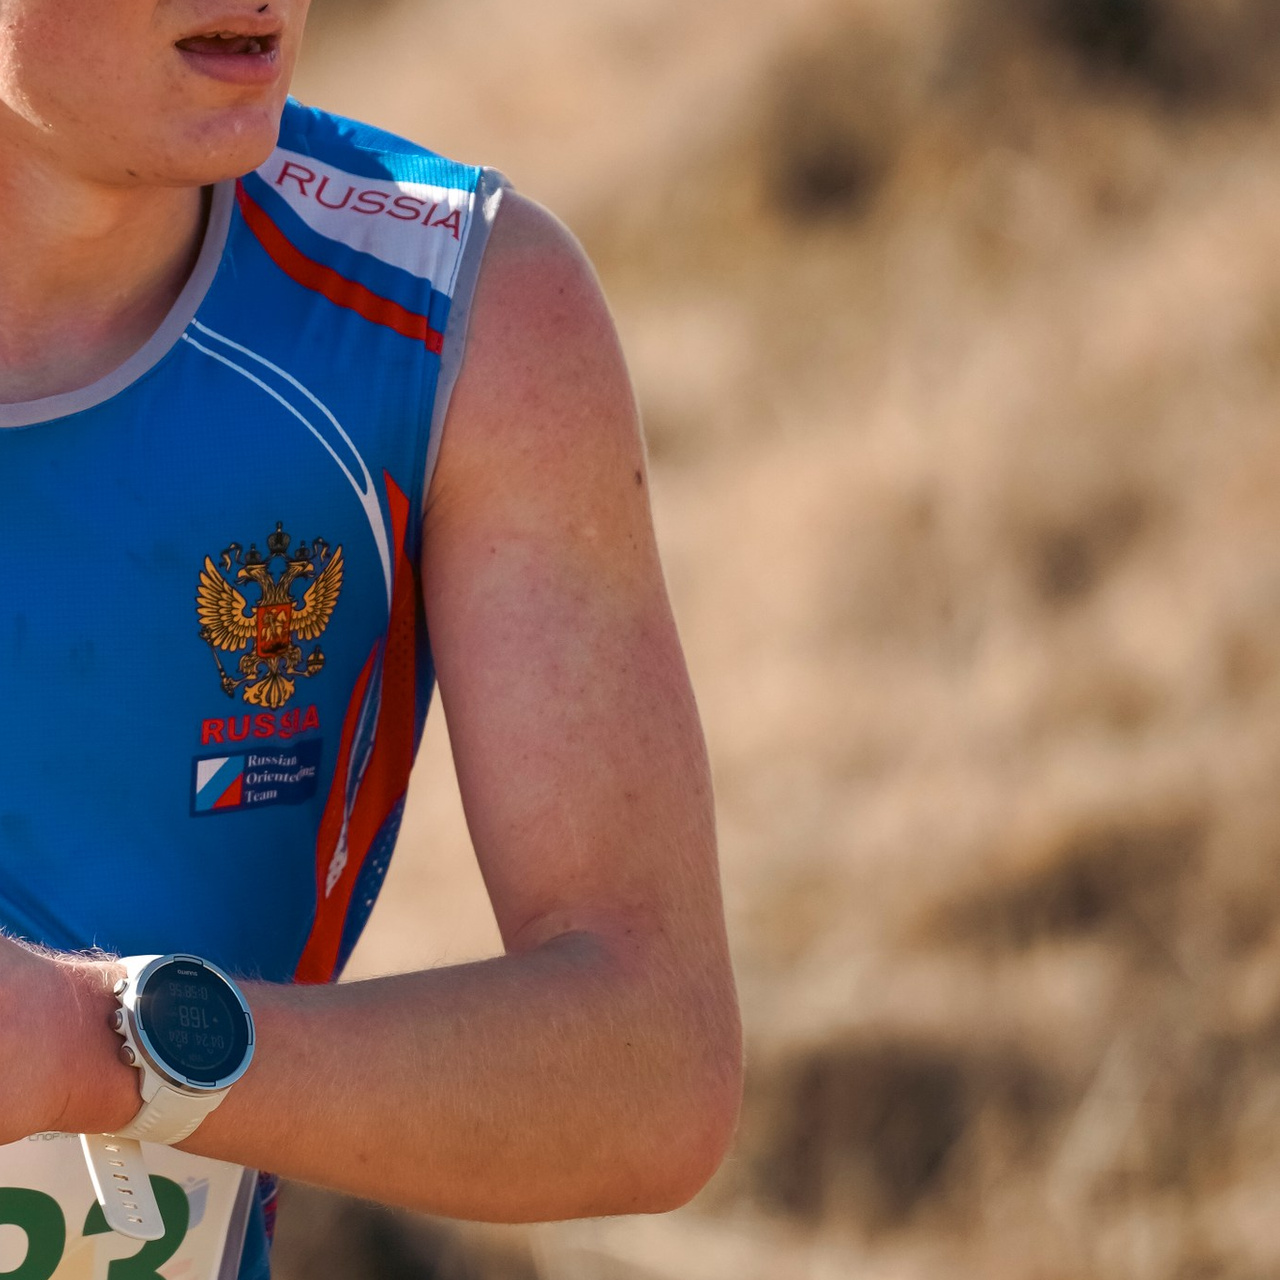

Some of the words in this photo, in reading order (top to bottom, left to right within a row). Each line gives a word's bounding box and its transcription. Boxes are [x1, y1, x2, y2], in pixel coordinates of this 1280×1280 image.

[275, 160, 462, 241] RUSSIA
[201, 704, 320, 745] RUSSIA
[247, 754, 297, 768] Russian
[246, 789, 278, 803] Team
